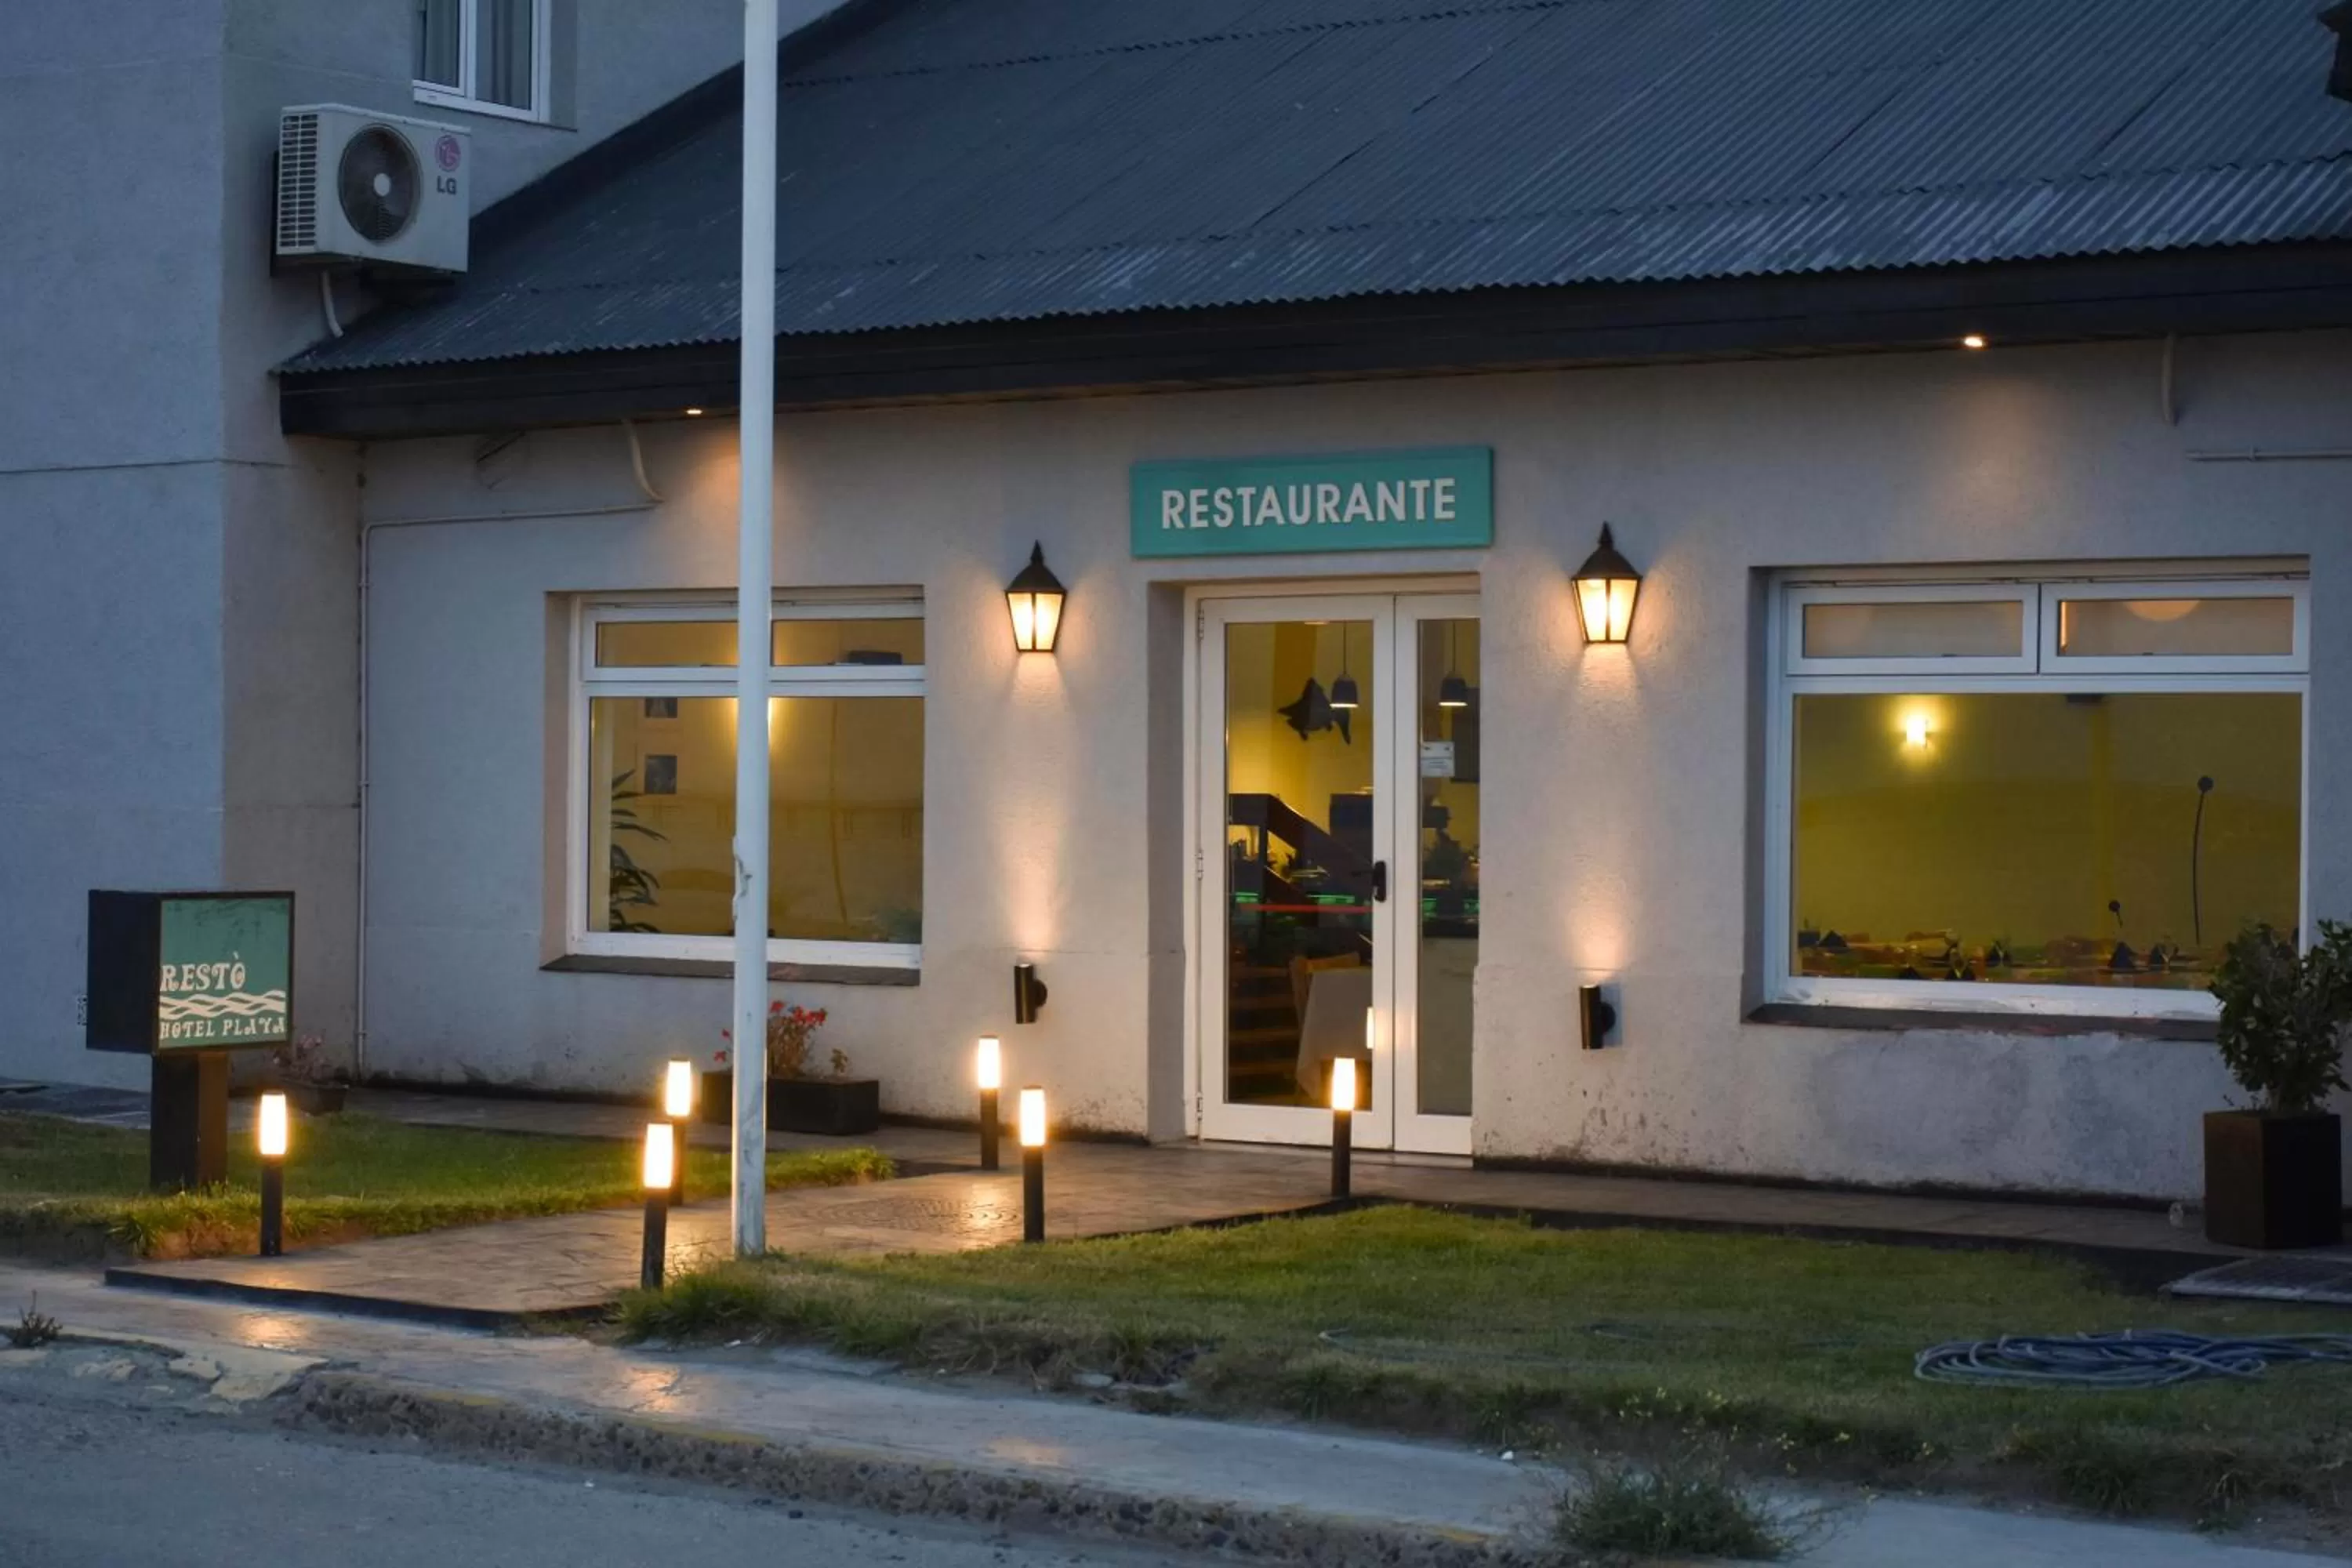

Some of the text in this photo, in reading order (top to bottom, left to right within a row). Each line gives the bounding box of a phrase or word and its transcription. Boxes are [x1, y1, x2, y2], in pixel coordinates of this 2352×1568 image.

[437, 175, 457, 195] LG
[1161, 477, 1456, 530] RESTAURANTE
[159, 1017, 286, 1040] HOTEL PLAYA
